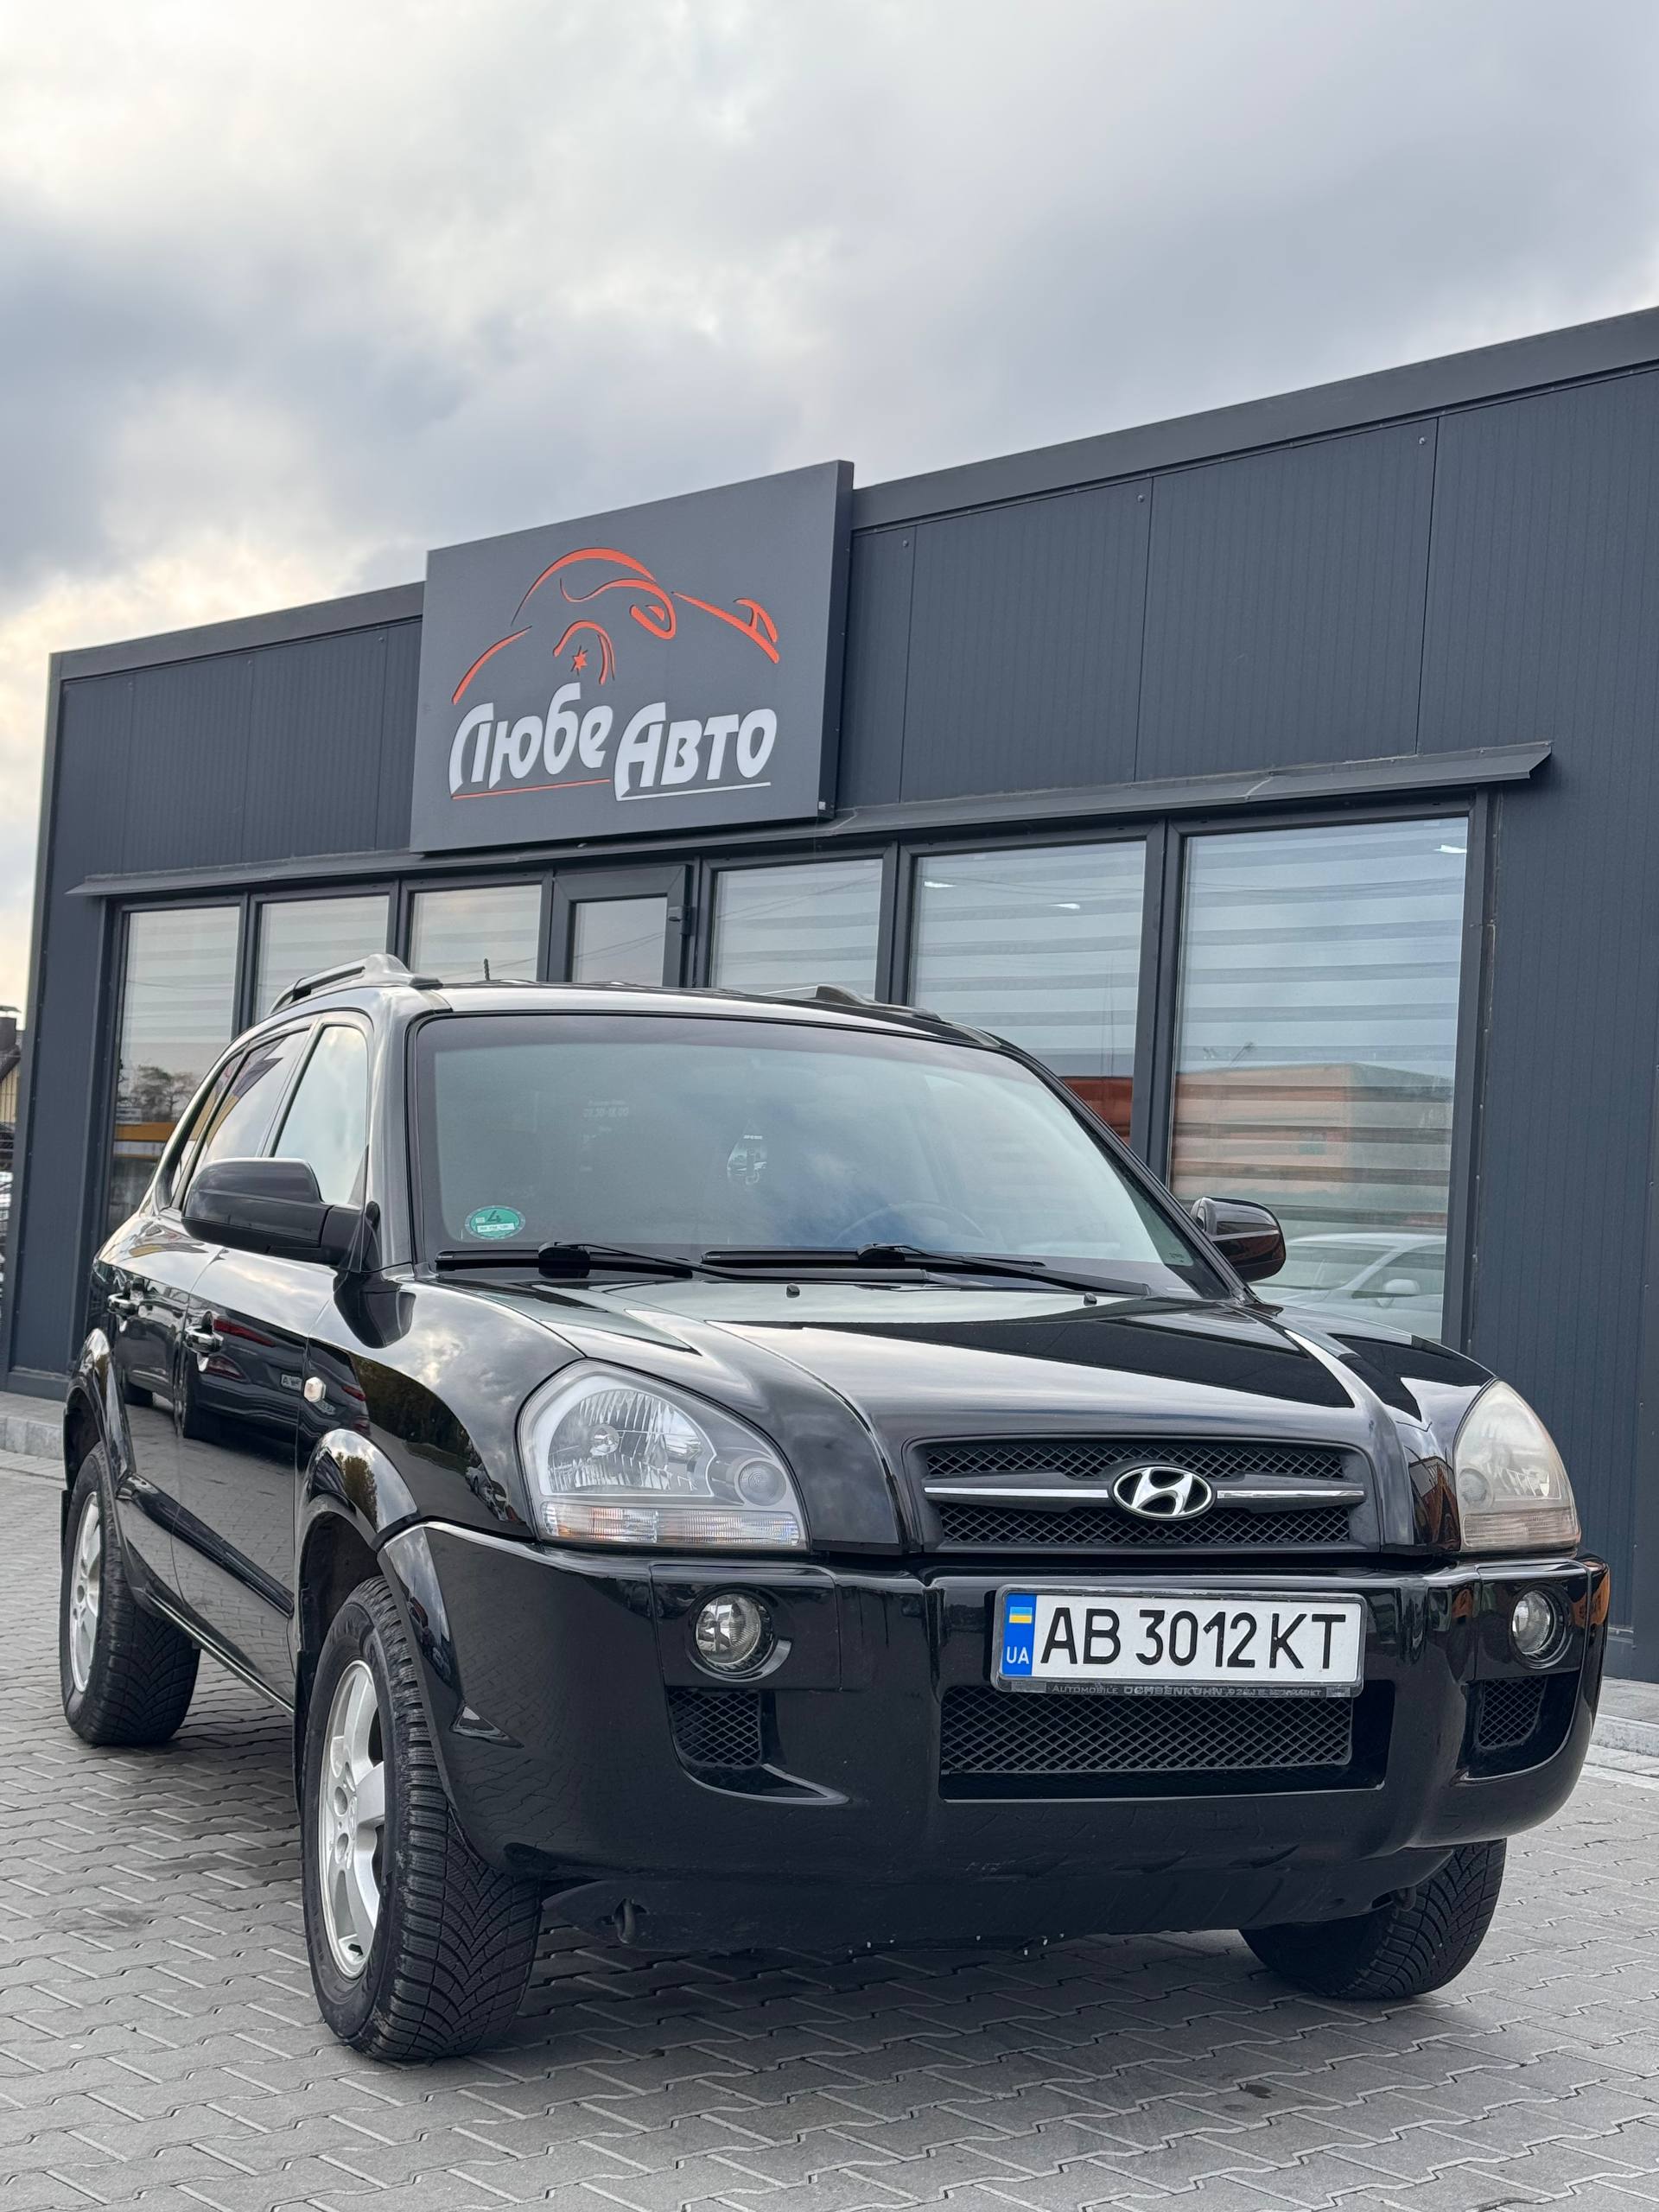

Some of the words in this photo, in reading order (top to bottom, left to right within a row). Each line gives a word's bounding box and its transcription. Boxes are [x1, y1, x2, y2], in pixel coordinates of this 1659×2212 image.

[448, 682, 613, 796] Любе
[614, 702, 778, 801] Авто
[1005, 1645, 1030, 1665] UA
[1039, 1606, 1122, 1665] AB
[1135, 1609, 1257, 1668] 3012
[1268, 1611, 1347, 1669] KT
